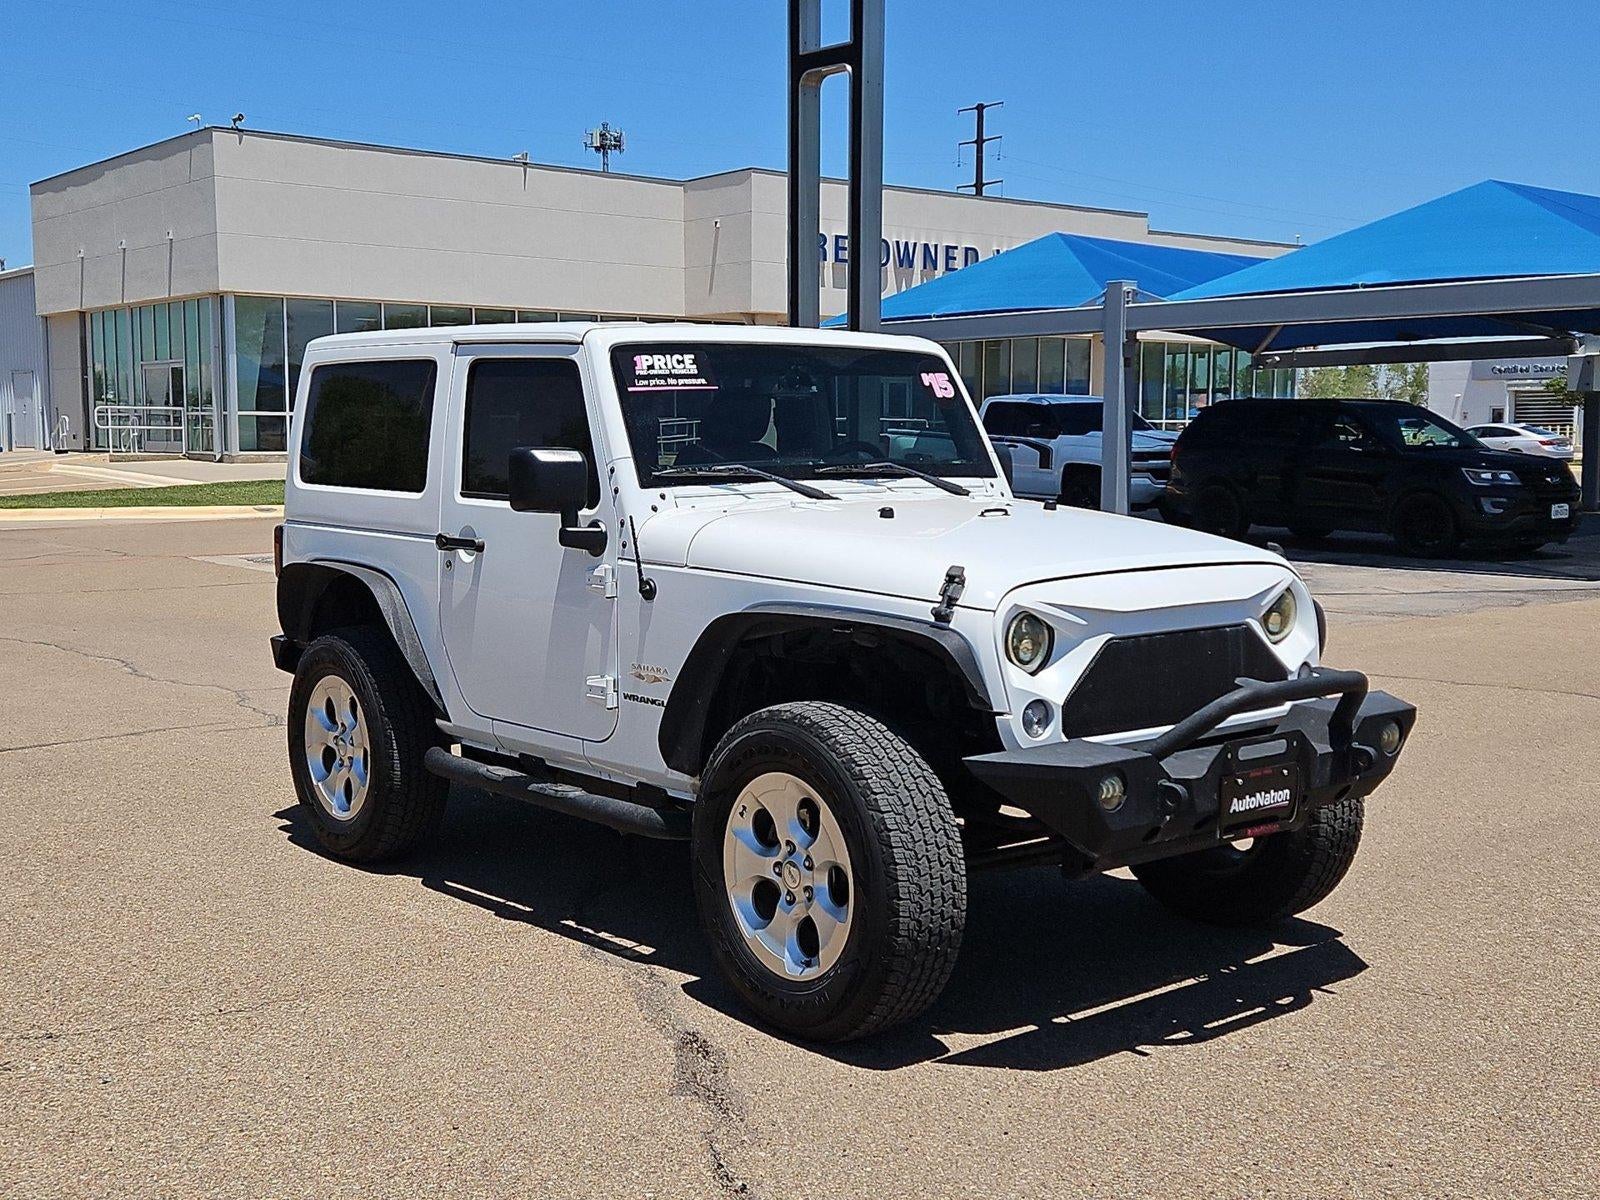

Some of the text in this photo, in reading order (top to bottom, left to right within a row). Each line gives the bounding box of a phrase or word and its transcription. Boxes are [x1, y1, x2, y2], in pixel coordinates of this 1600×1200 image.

[649, 378, 667, 386] price.
[631, 663, 669, 675] SAHARA
[1229, 788, 1290, 813] AutoNation
